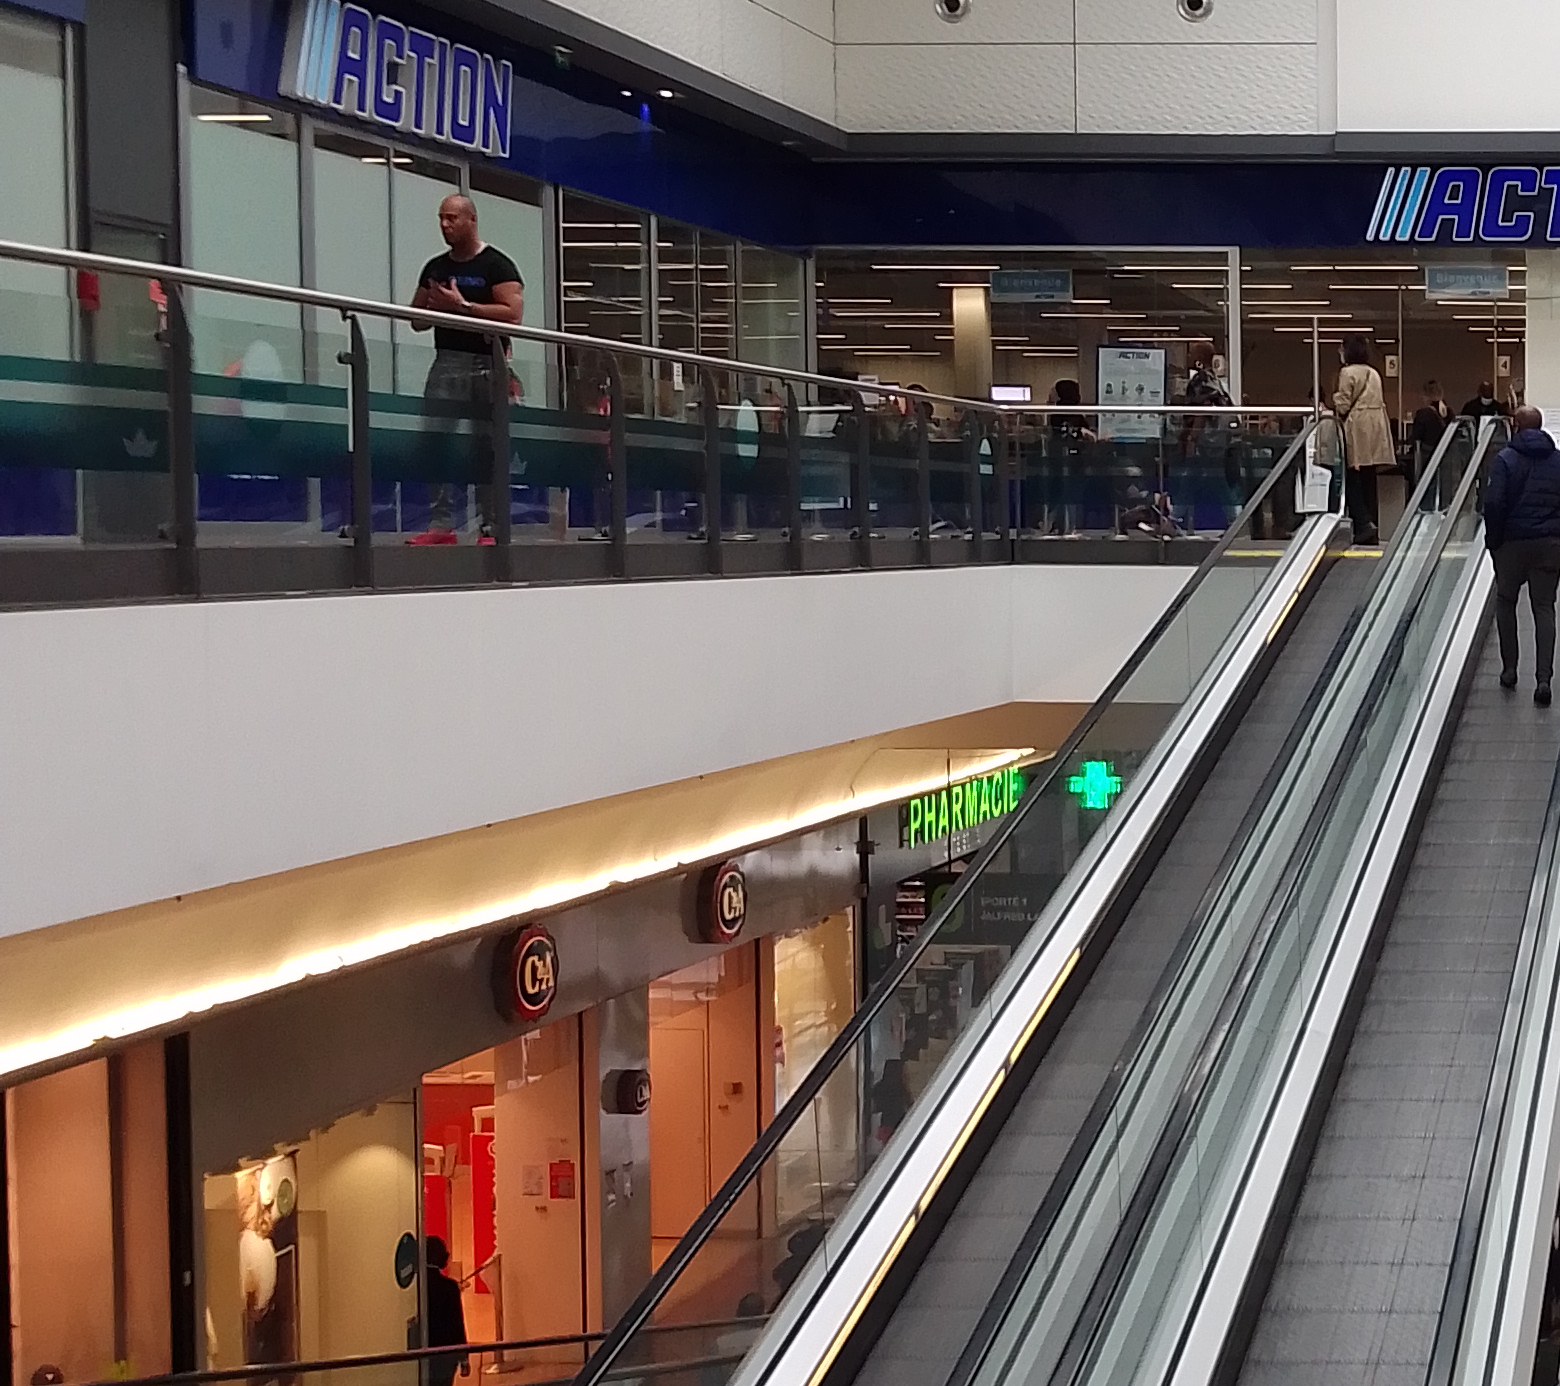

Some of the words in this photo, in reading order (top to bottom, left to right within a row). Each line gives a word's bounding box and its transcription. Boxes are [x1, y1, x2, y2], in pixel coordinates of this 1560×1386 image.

[330, 2, 513, 159] ACTION
[999, 277, 1062, 289] Benvenue
[1117, 351, 1151, 360] ACTION
[909, 768, 1019, 850] PHARMACIE
[723, 882, 745, 921] C&A
[524, 949, 555, 995] C&A
